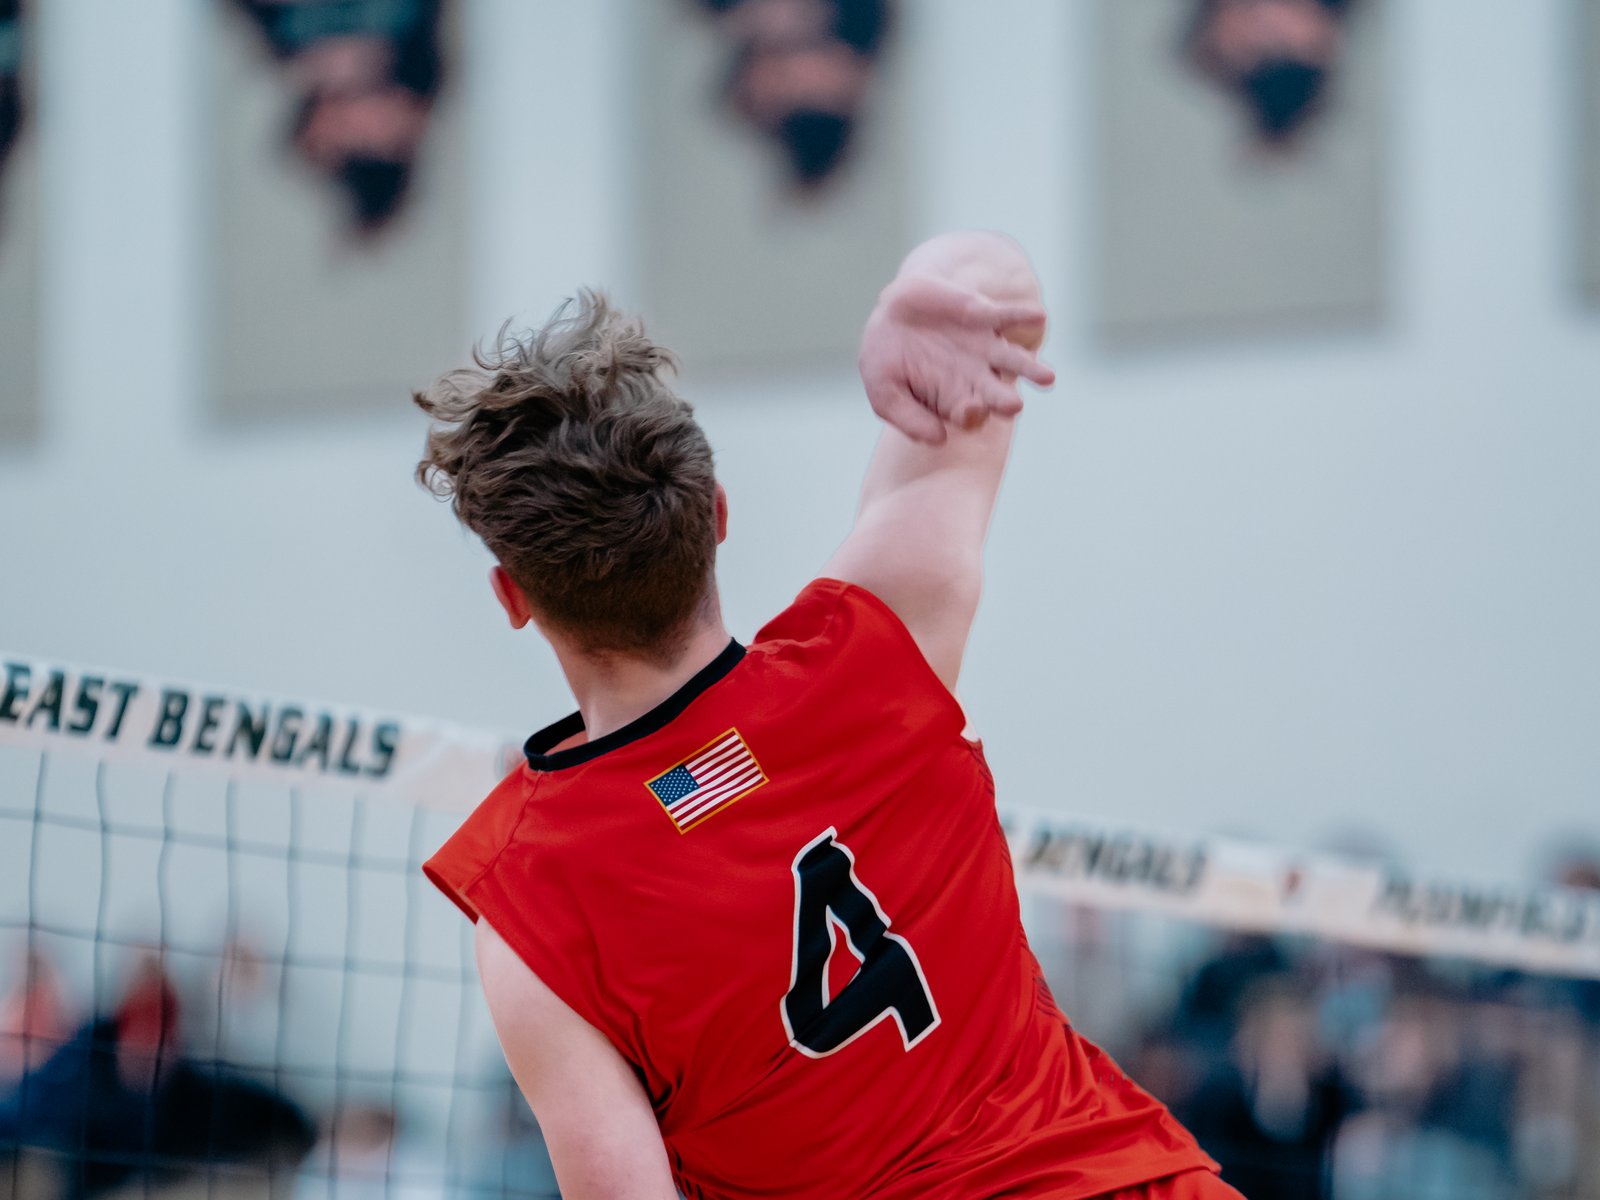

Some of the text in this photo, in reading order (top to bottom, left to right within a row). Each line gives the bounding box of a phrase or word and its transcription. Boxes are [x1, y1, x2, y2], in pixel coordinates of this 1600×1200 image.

[0, 662, 402, 779] EAST BENGALS
[780, 825, 941, 1059] 4
